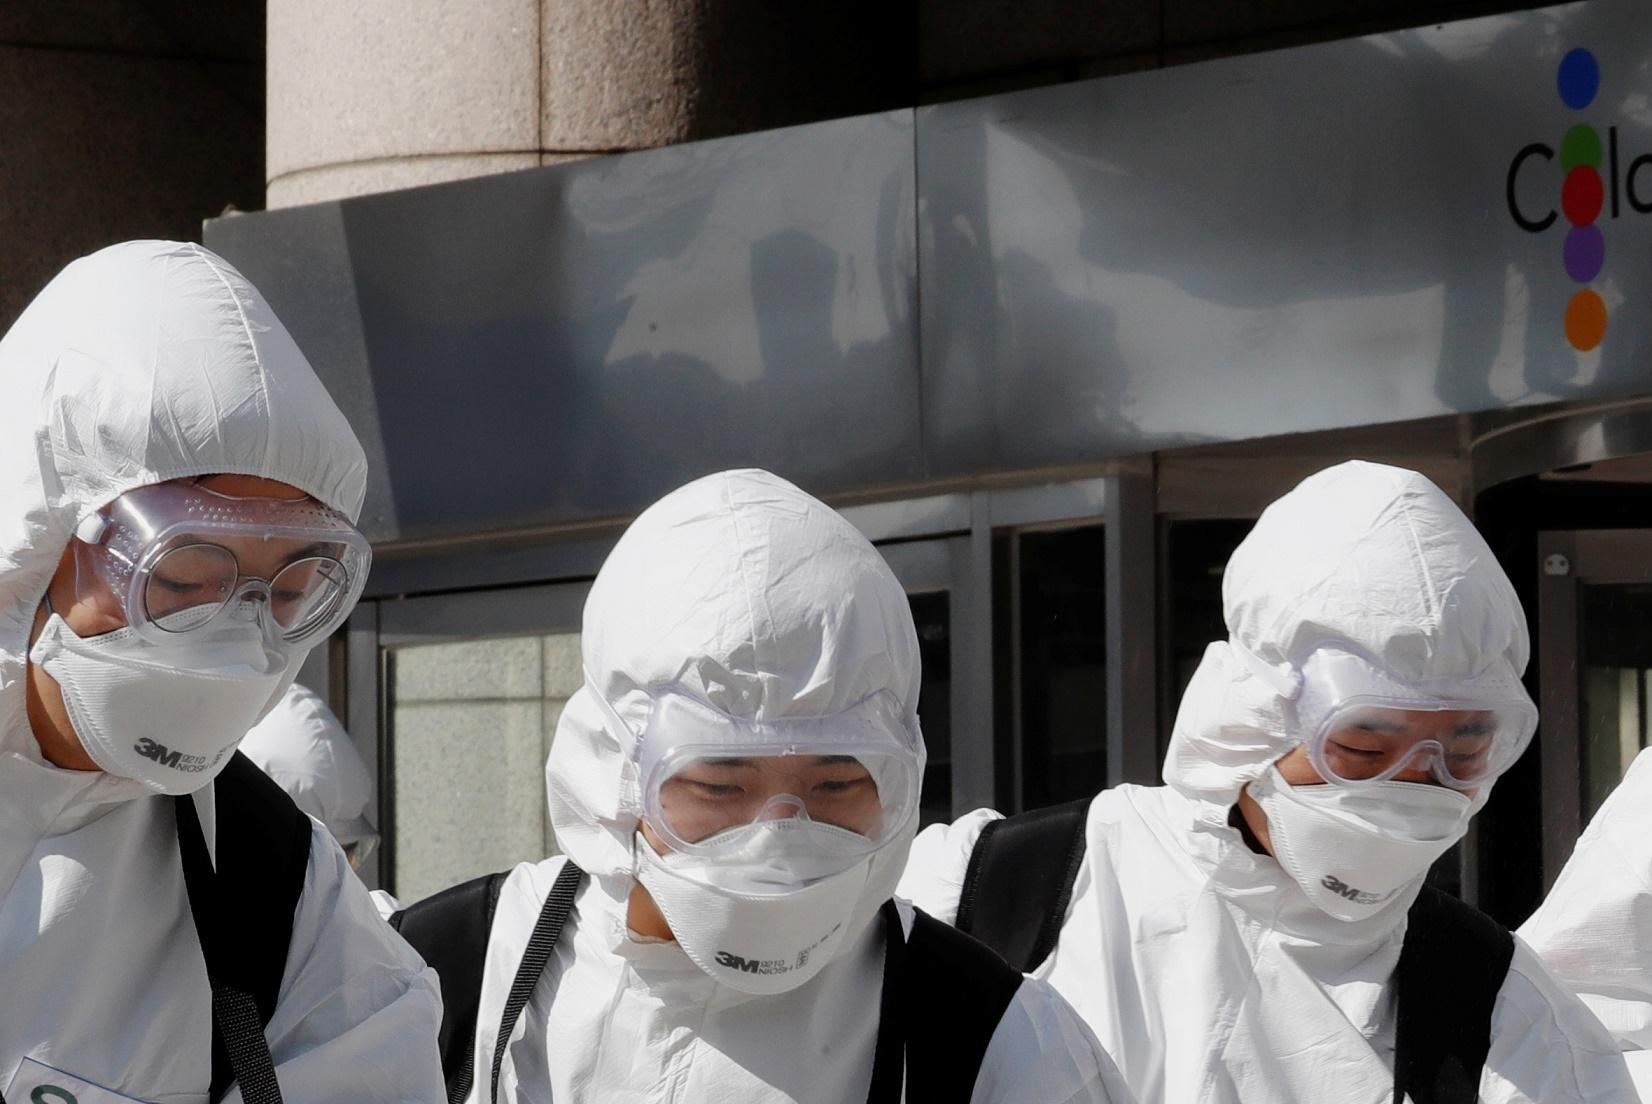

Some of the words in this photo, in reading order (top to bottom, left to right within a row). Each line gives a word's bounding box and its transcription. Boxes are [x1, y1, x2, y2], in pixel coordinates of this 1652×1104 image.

[133, 737, 183, 768] 3M
[1321, 874, 1360, 901] 3M
[714, 950, 760, 974] 3M
